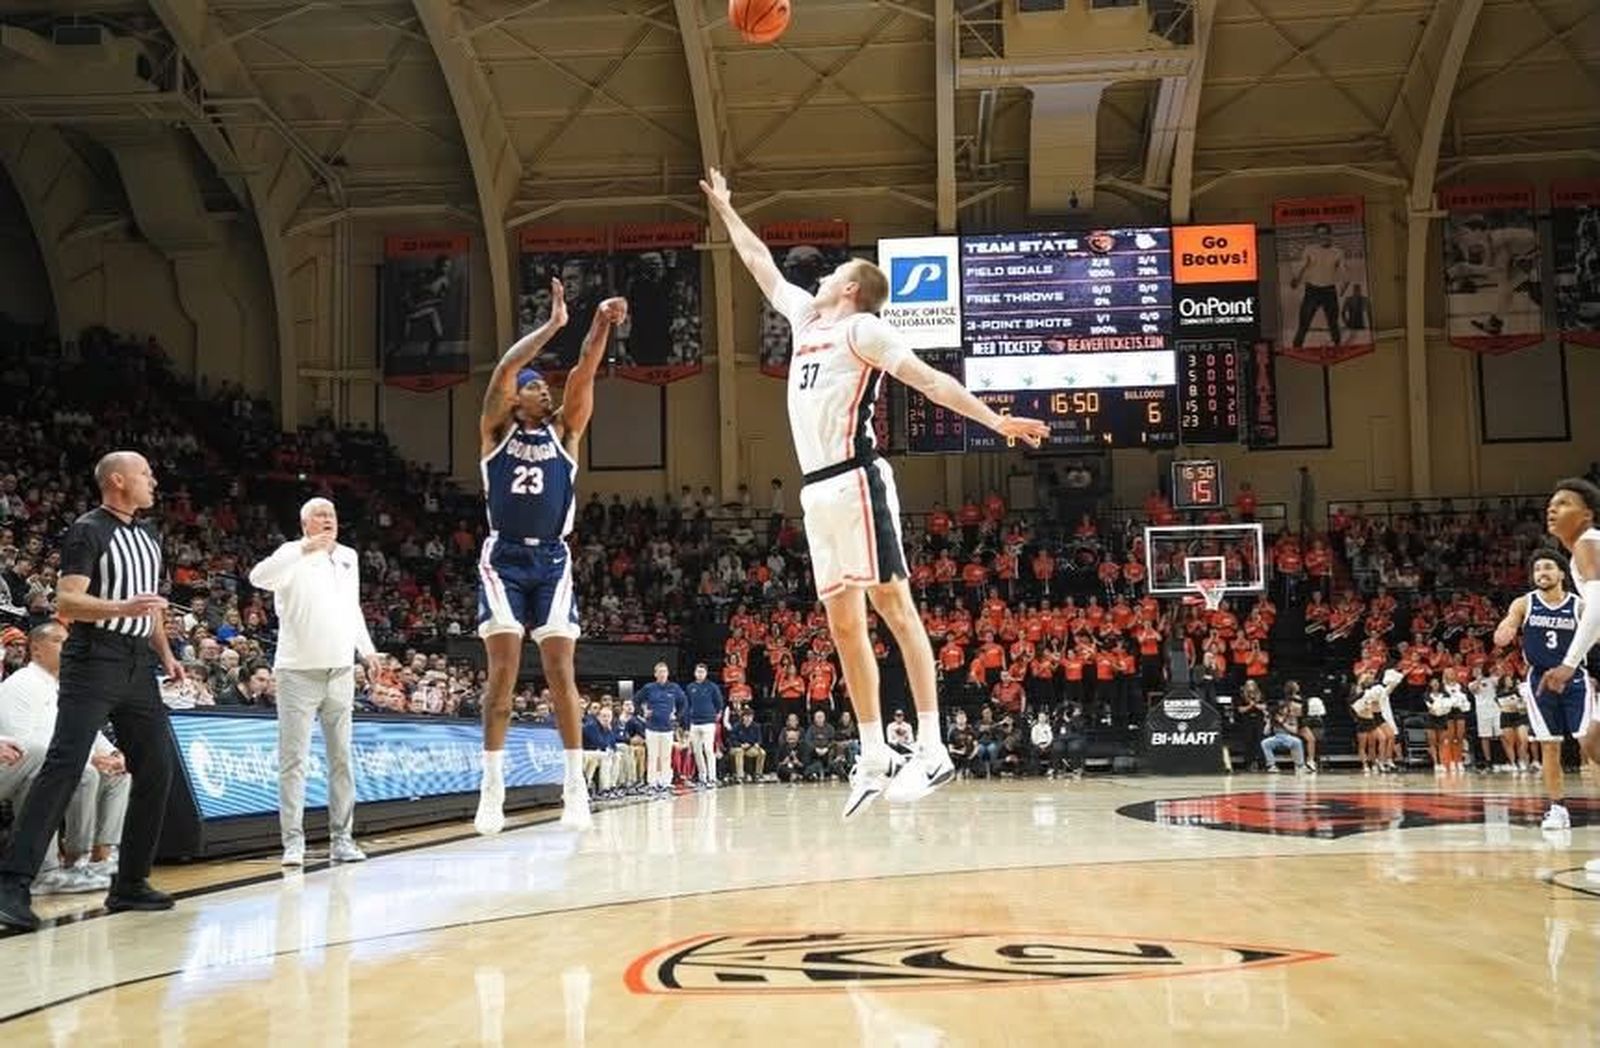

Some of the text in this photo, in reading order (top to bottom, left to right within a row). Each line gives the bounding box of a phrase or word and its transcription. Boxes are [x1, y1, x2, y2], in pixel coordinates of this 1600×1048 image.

[965, 242, 1015, 253] TEAM
[1202, 236, 1228, 249] Go
[1182, 249, 1248, 266] Beavs!
[966, 264, 1053, 276] FIELD GOALS
[966, 291, 1064, 304] FREE THROWS
[883, 307, 956, 318] PACIFIC OFFICE
[1180, 297, 1254, 317] OnPoint
[966, 317, 1072, 331] 3-POINT SHOTS
[972, 341, 998, 355] NEED
[1066, 335, 1164, 351] BEAVERTICKETS.COM
[1188, 353, 1233, 367] 3 0 0
[800, 363, 820, 390] 37
[1188, 369, 1234, 382] 5 0 0
[1189, 384, 1197, 397] 8
[1208, 384, 1216, 396] 0
[1050, 392, 1099, 414] 16:50
[1186, 398, 1235, 412] 15 0 2
[1148, 402, 1161, 423] 6
[1084, 416, 1090, 431] 1
[1182, 415, 1199, 427] 23
[1228, 414, 1236, 426] 0
[1103, 432, 1112, 443] 4
[511, 466, 544, 494] 23
[1192, 480, 1211, 503] 15
[1545, 631, 1558, 649] 3
